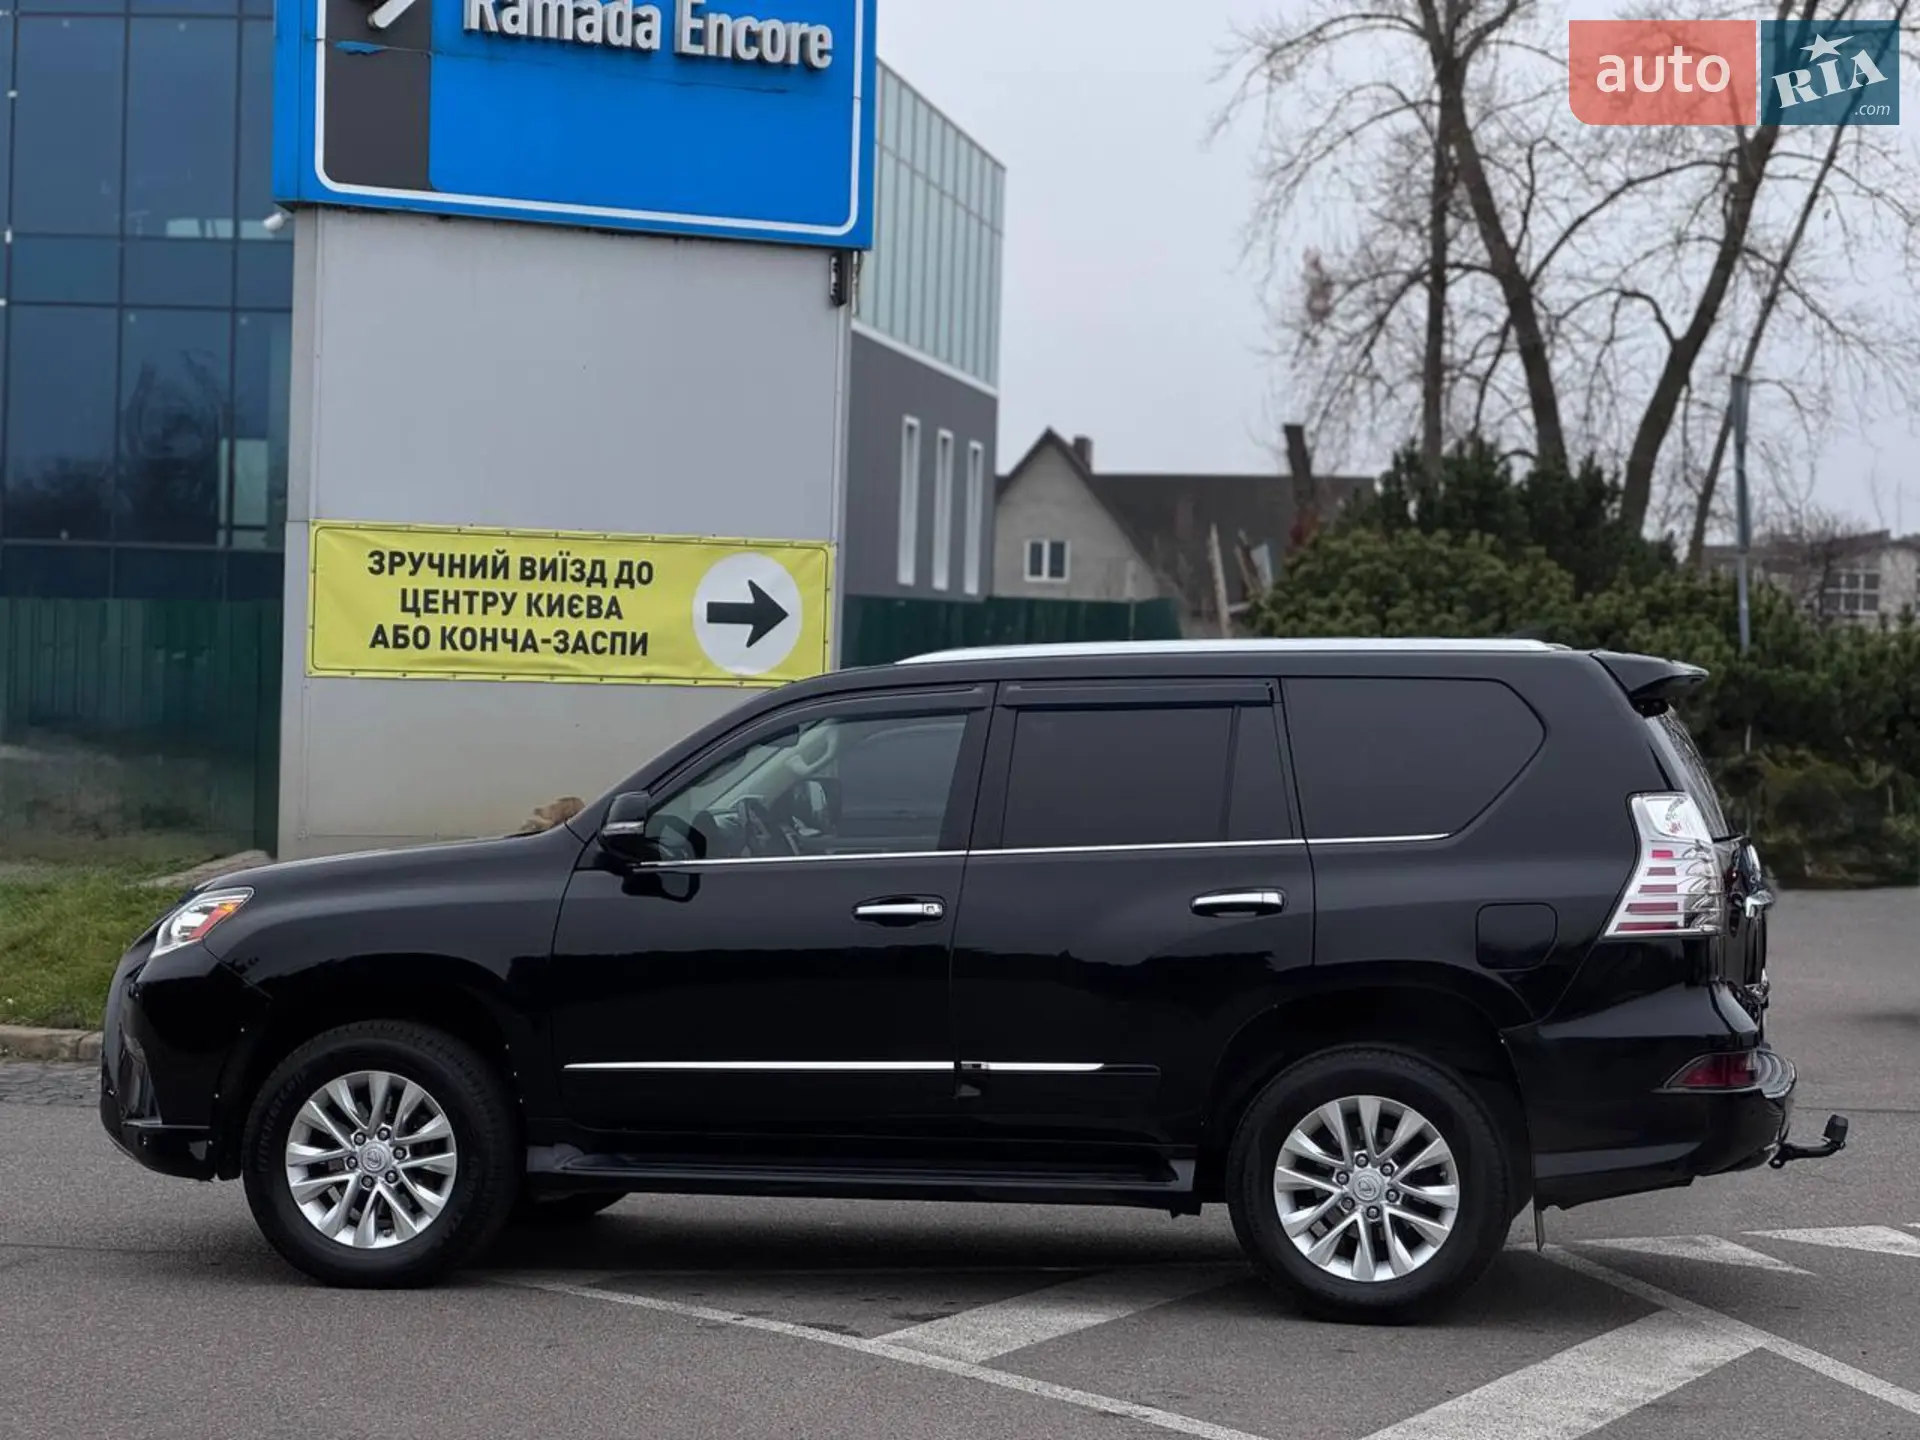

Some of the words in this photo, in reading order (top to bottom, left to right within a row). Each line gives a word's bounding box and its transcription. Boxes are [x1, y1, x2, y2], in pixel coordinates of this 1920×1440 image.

[675, 0, 833, 69] Encore
[367, 549, 510, 580] ЗРУЧНИЙ
[519, 552, 608, 589] ВИЇЗД
[613, 560, 654, 590] ДО
[400, 588, 518, 618] ЦЕНТРУ
[526, 592, 623, 620] КИЄВА
[369, 623, 431, 650] АБО
[440, 625, 649, 657] КОНЧА-ЗАСПИ
